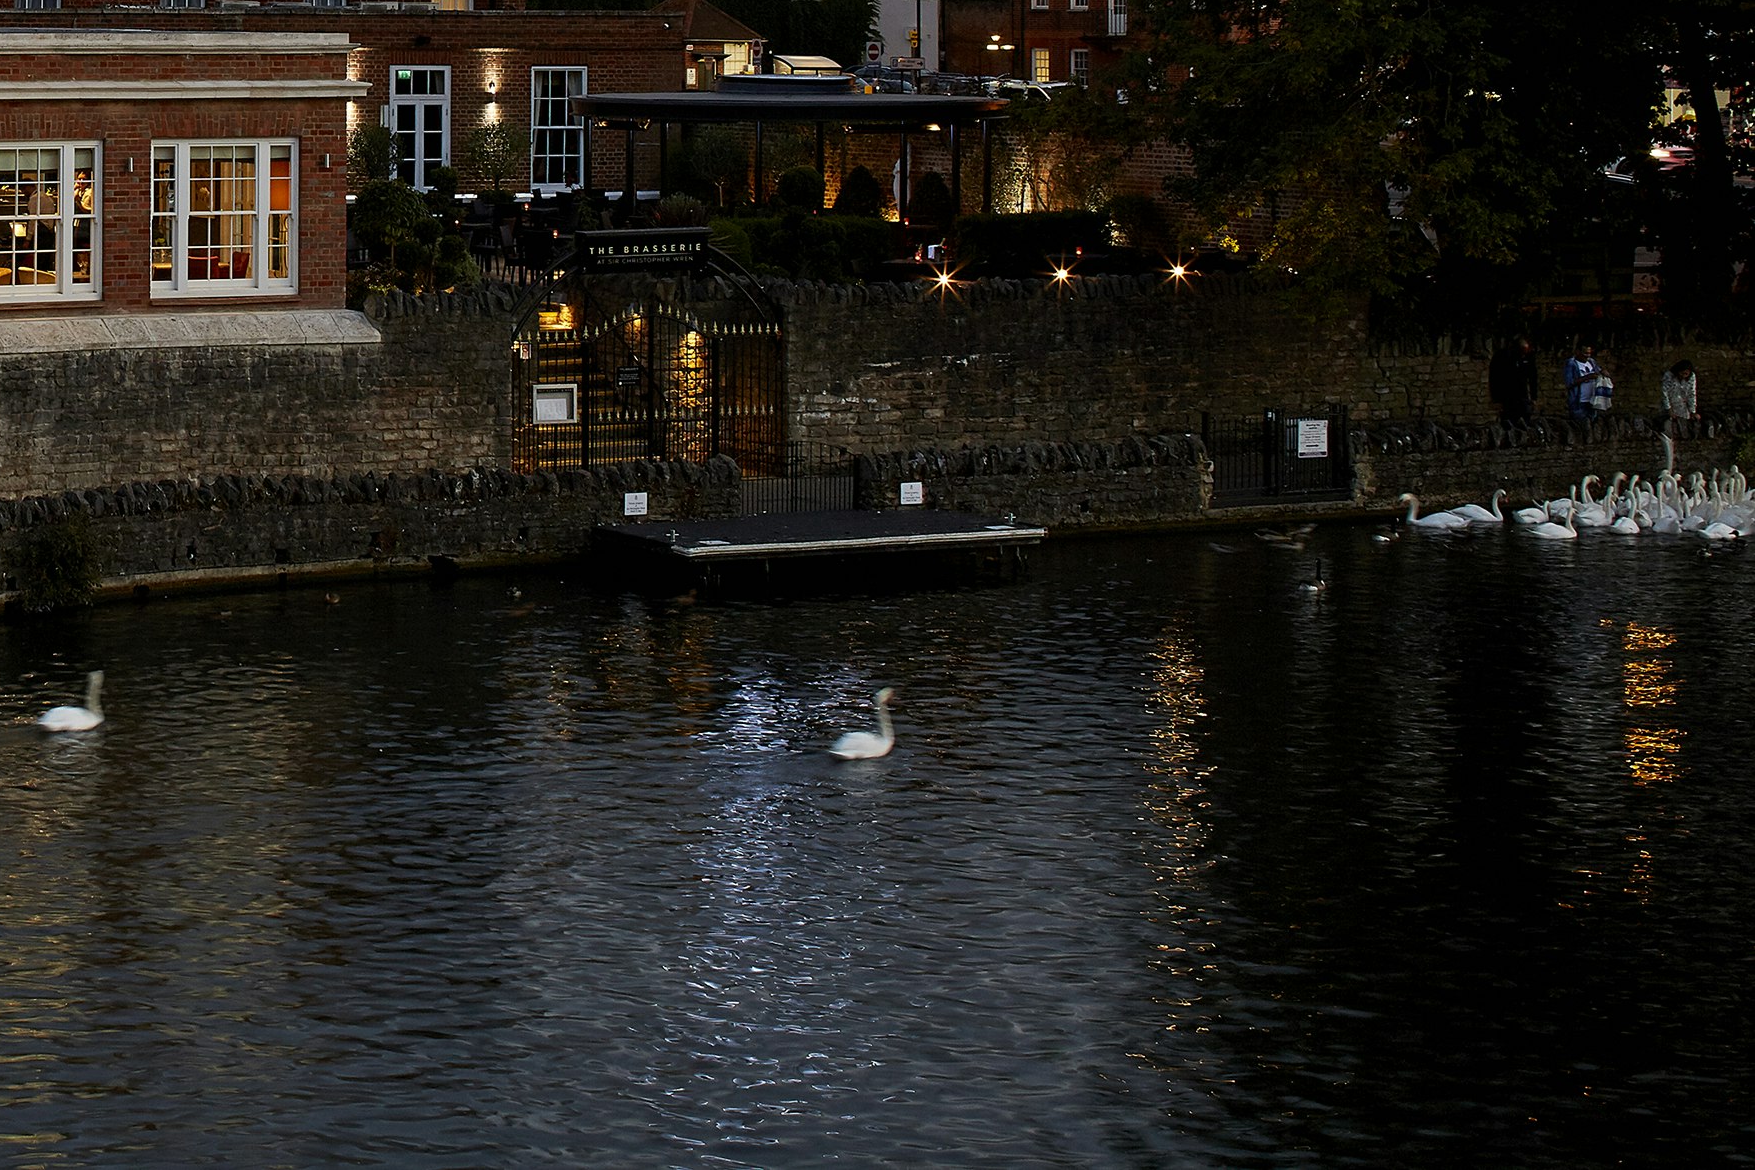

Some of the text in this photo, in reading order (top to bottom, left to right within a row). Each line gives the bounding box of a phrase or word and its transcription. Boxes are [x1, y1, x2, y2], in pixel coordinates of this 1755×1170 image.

[589, 243, 701, 255] THE BRASSERIE
[621, 256, 671, 264] CHRISTOPHER
